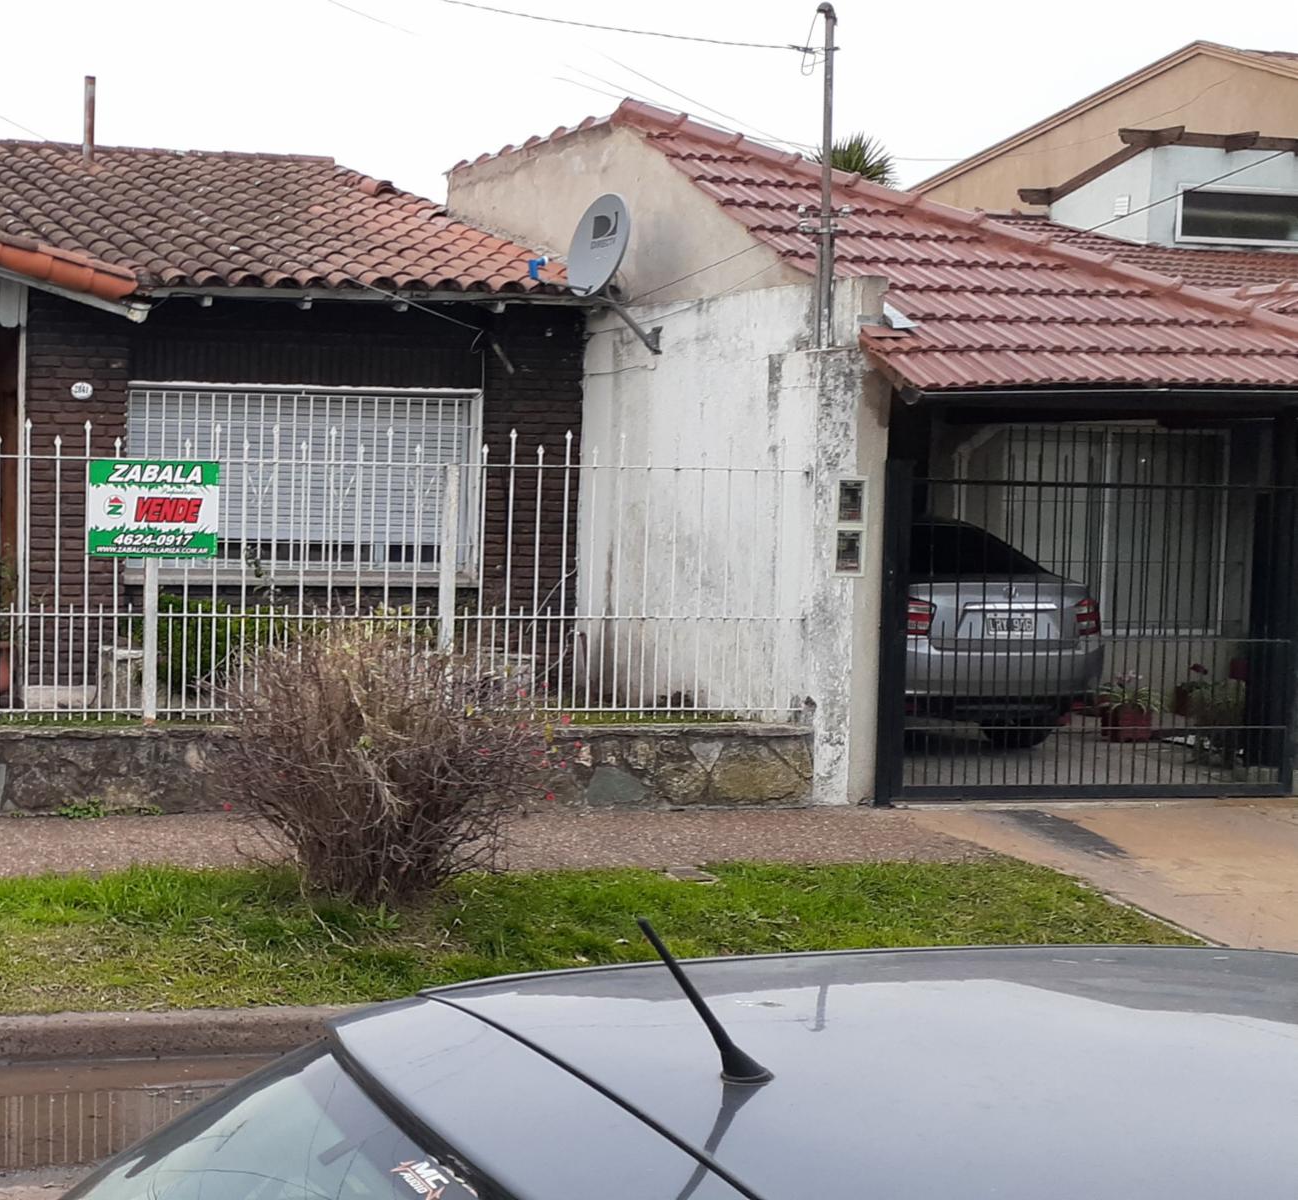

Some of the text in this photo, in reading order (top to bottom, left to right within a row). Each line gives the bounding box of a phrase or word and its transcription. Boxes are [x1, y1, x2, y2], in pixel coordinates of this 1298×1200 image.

[107, 464, 203, 483] ZABALA
[134, 497, 203, 523] VENDE
[113, 533, 194, 546] 4624-0917
[399, 1172, 429, 1194] AUDIO
[410, 1160, 450, 1189] MC
